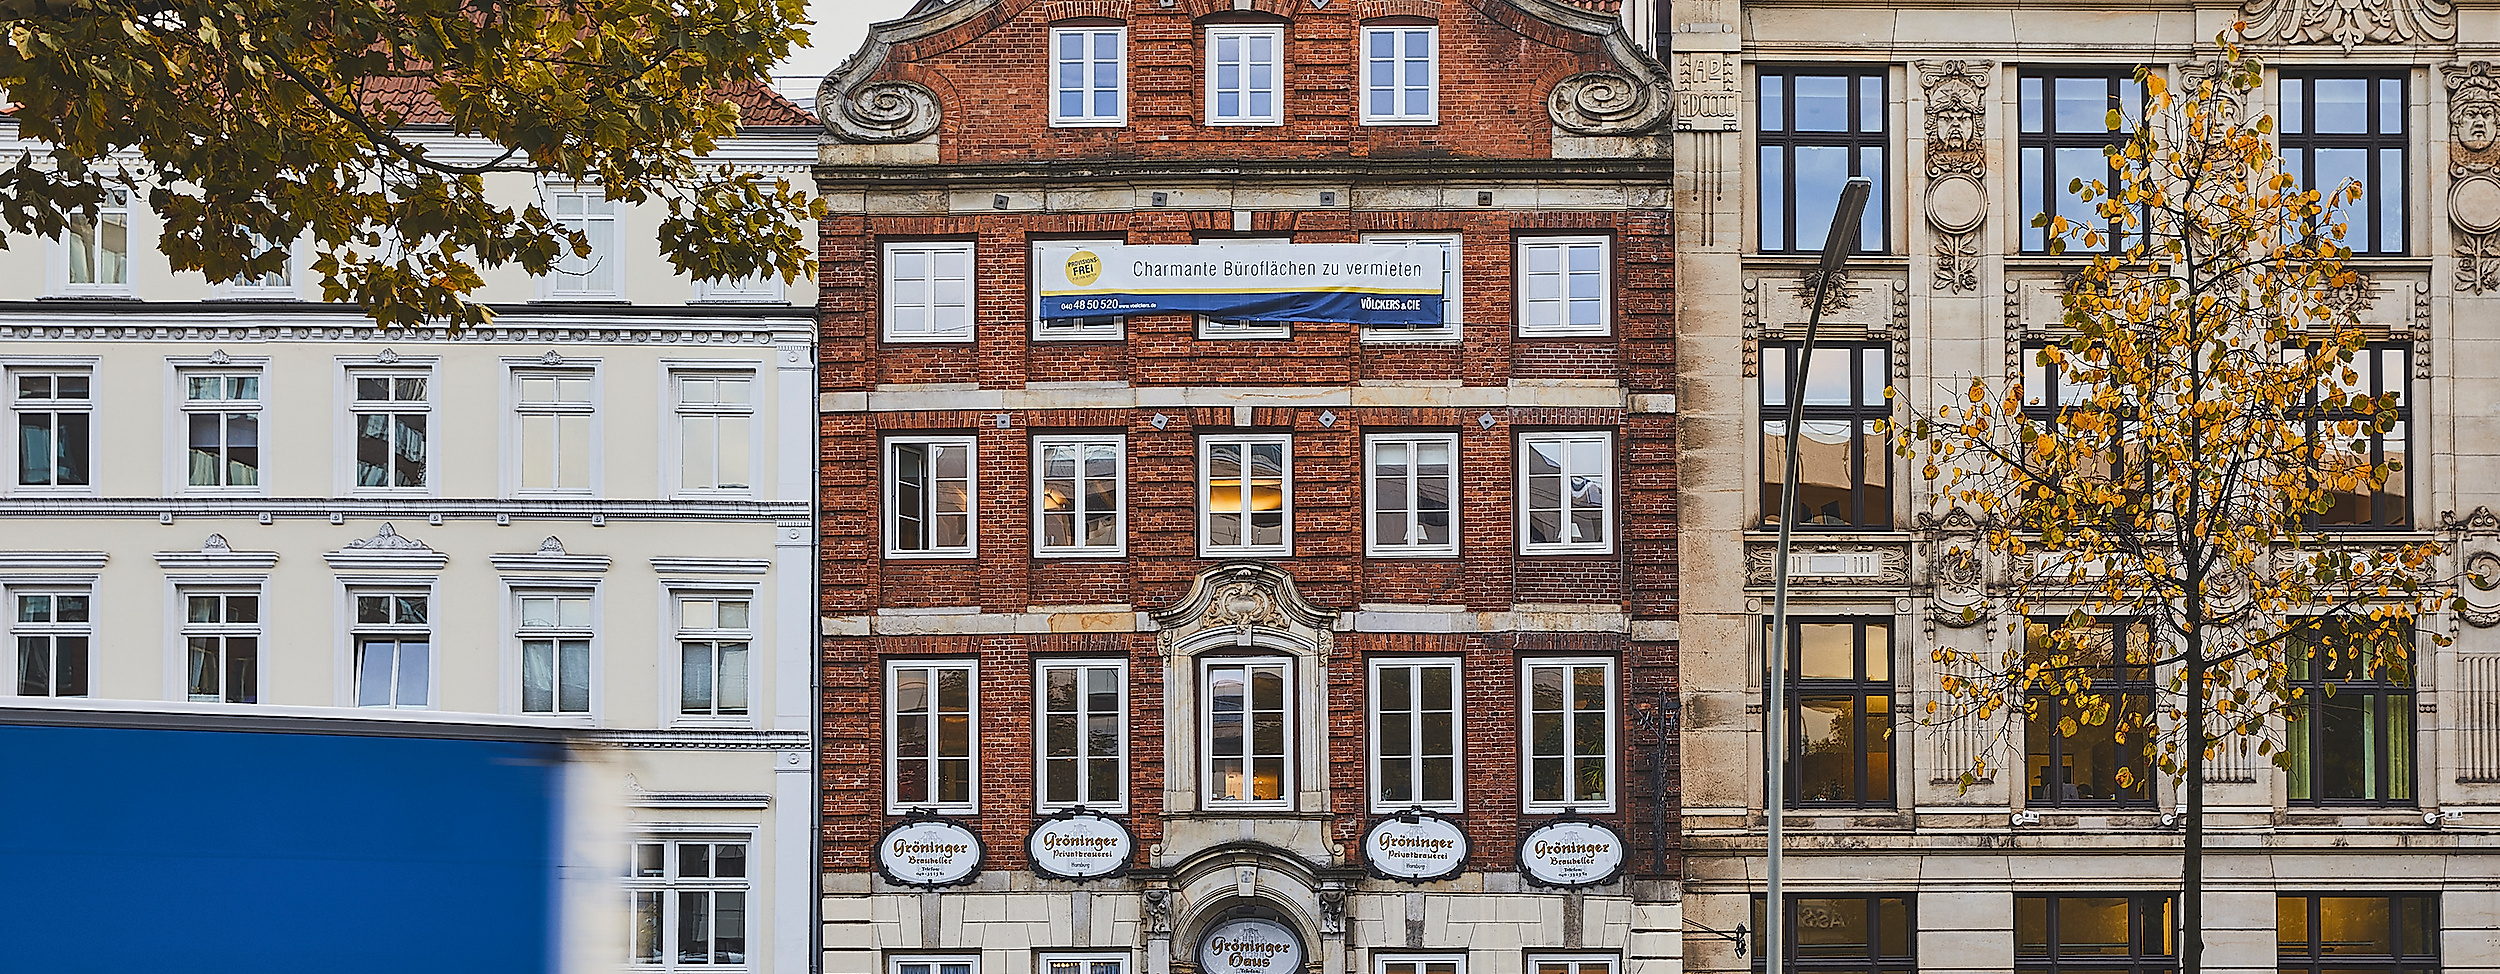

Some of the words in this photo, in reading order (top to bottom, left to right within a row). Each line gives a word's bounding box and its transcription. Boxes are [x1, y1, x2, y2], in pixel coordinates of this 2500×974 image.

[1072, 263, 1094, 277] FREI
[1133, 260, 1217, 277] Charmante
[1224, 260, 1316, 277] Büroflächen
[1322, 263, 1339, 276] zu
[1346, 260, 1422, 277] vermieten
[1100, 298, 1119, 309] 520
[893, 839, 968, 858] Gröninger
[1043, 832, 1118, 851] Gröninger
[1379, 832, 1455, 853] Gröninger
[1534, 840, 1610, 859] Gröninger
[1052, 849, 1113, 860] Privatbrauerei
[1387, 849, 1449, 860] Privatbrauerei
[1211, 936, 1291, 958] Gröninger
[1228, 951, 1271, 968] Haus
